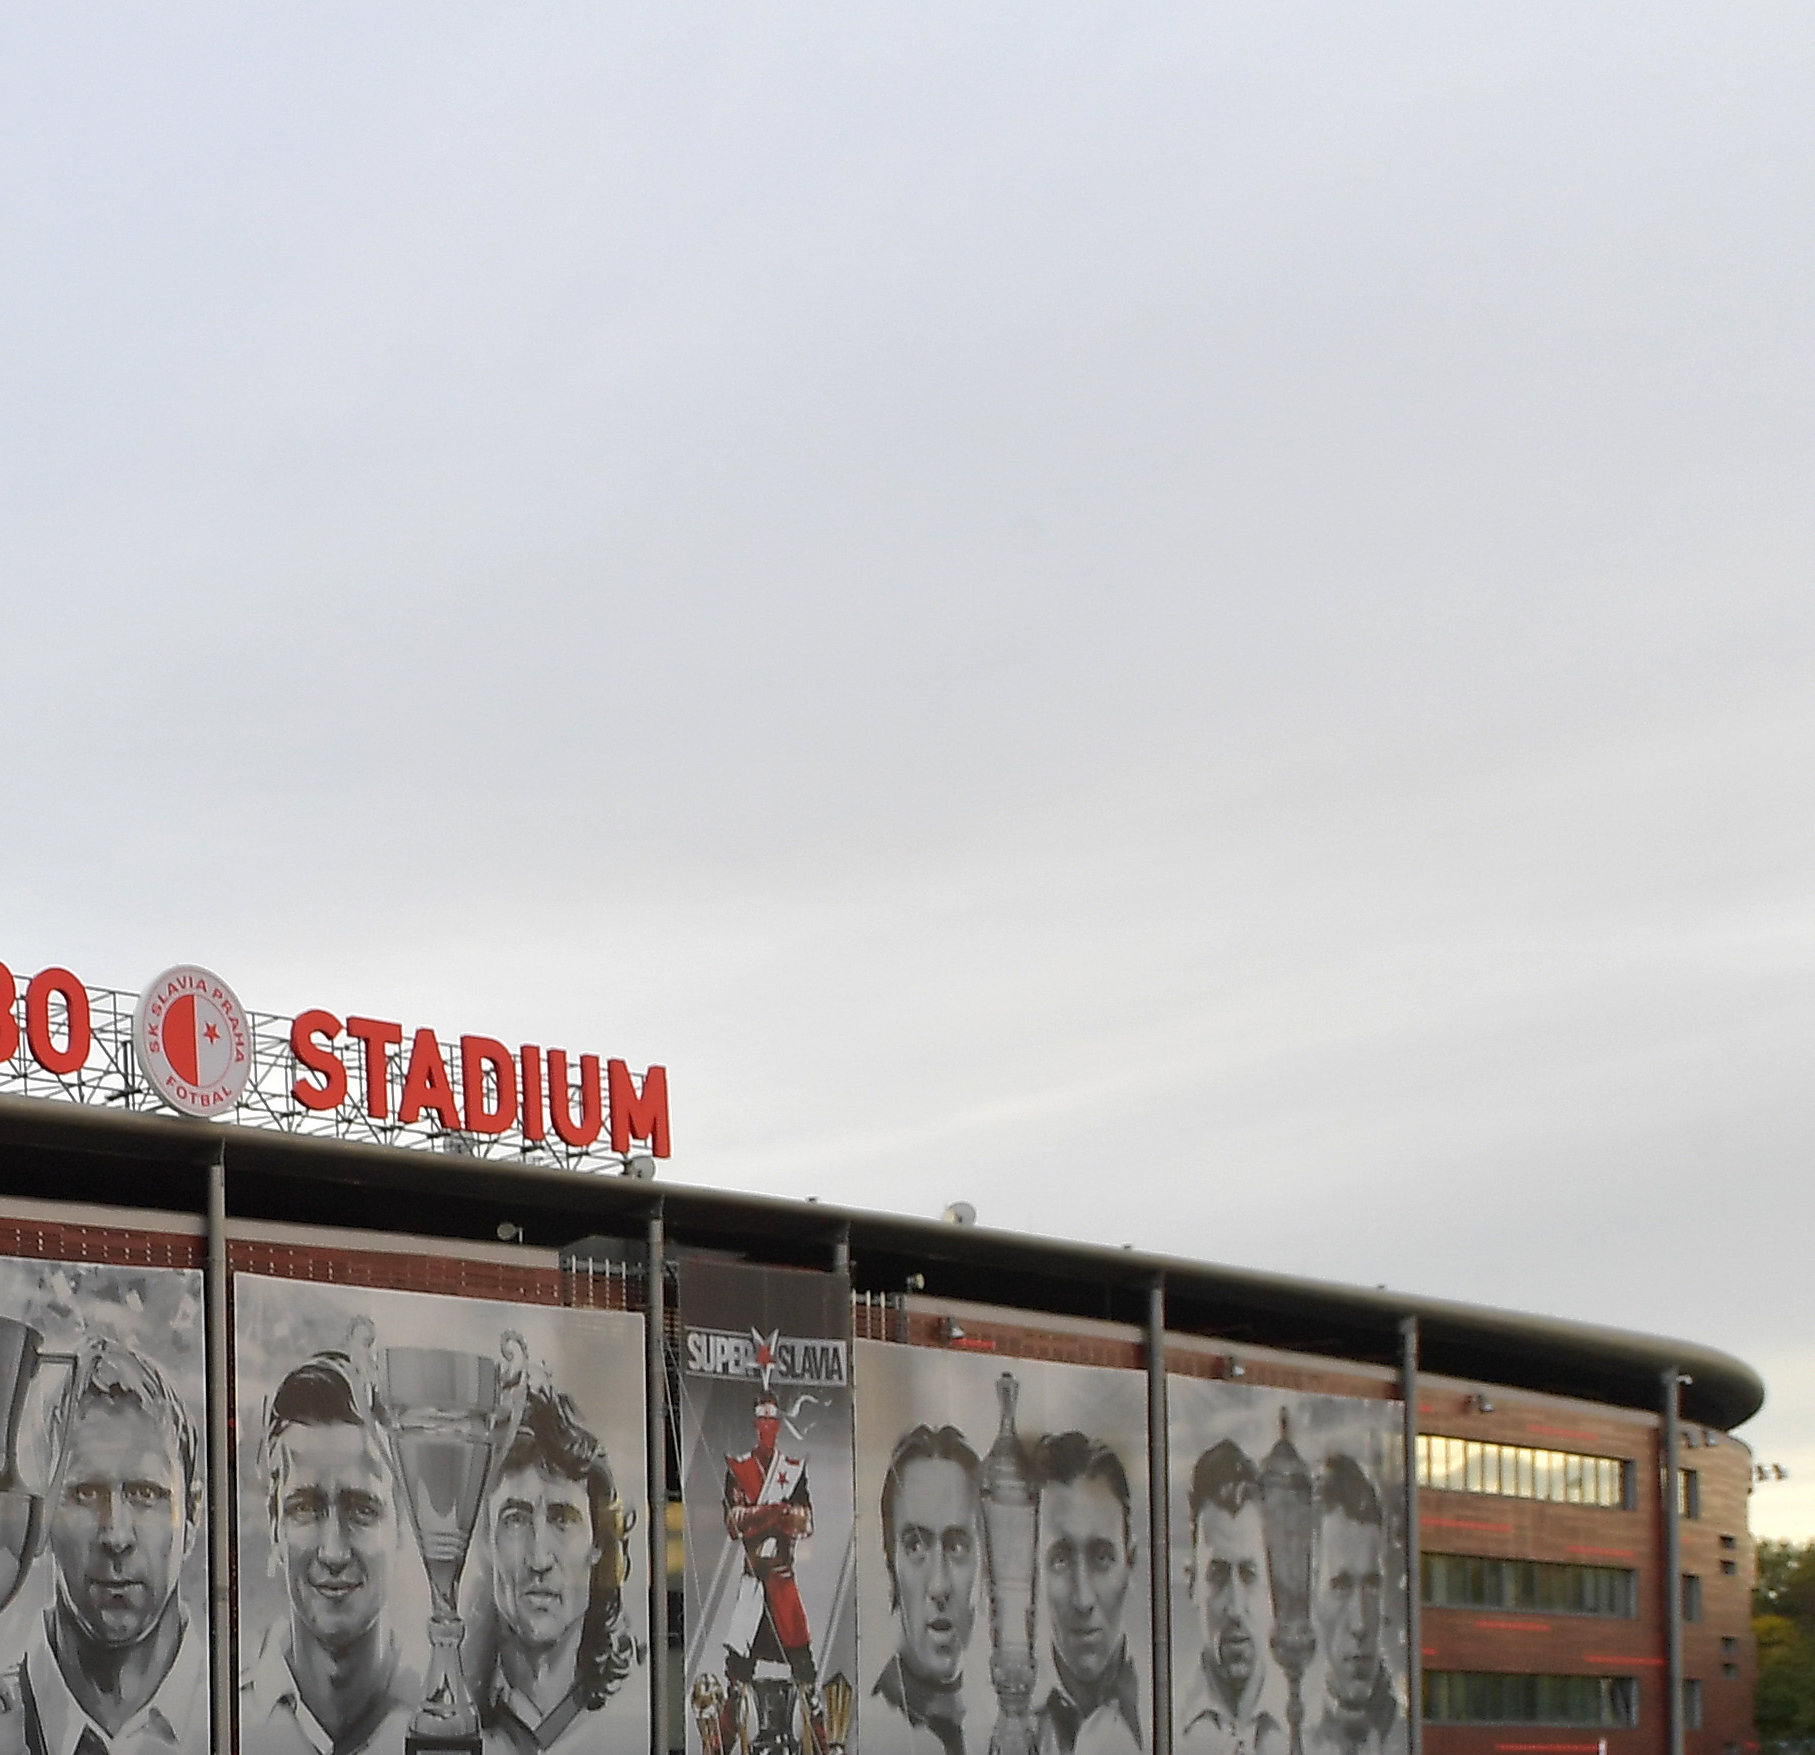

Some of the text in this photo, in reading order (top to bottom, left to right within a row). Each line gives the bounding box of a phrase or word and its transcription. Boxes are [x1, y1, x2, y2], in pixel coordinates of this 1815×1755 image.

[148, 975, 246, 1063] SK SLAVIA PRAHA
[165, 1075, 233, 1108] FOTBAL
[290, 1008, 672, 1159] STADIUM
[776, 1344, 843, 1381] SLAVIA
